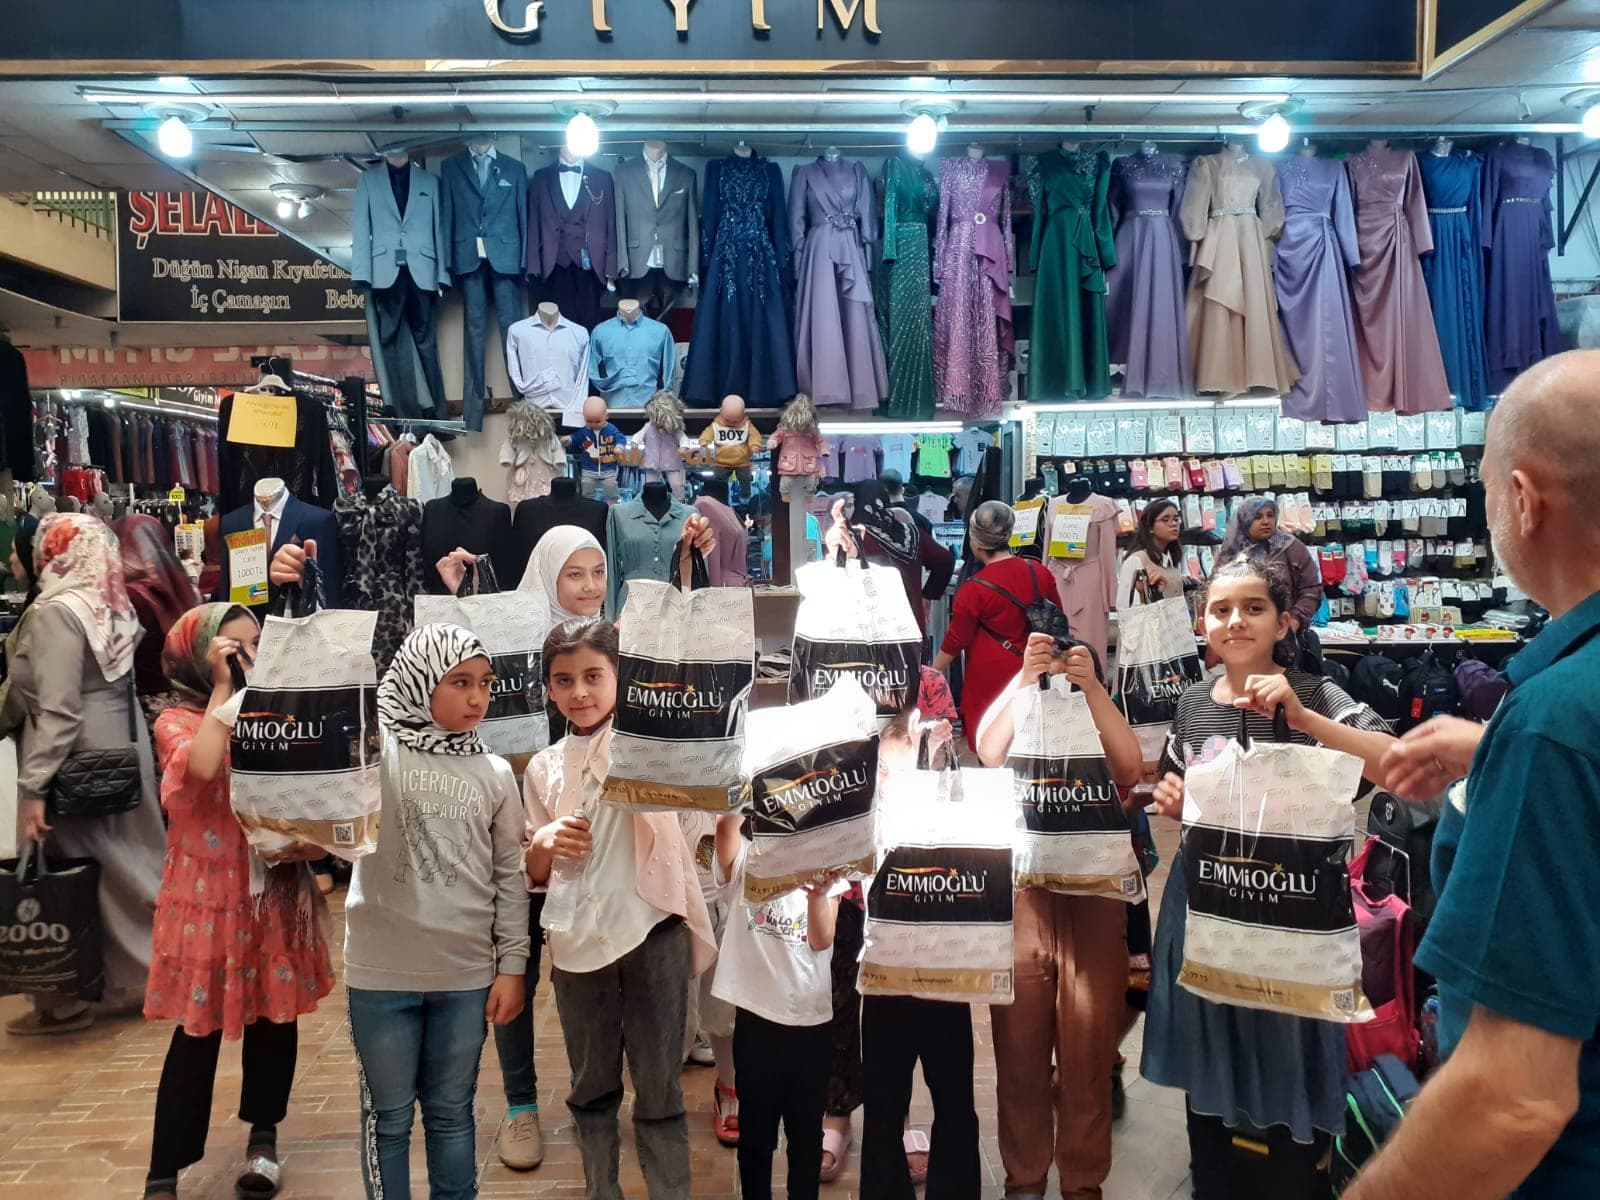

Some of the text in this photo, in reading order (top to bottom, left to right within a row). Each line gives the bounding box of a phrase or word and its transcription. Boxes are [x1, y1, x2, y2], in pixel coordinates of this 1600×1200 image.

[152, 257, 213, 282] Düğün
[216, 259, 269, 284] Nişan
[190, 285, 208, 313] İç
[212, 288, 291, 314] Çamaşırı
[193, 389, 214, 405] Giyim
[718, 429, 745, 442] BOY
